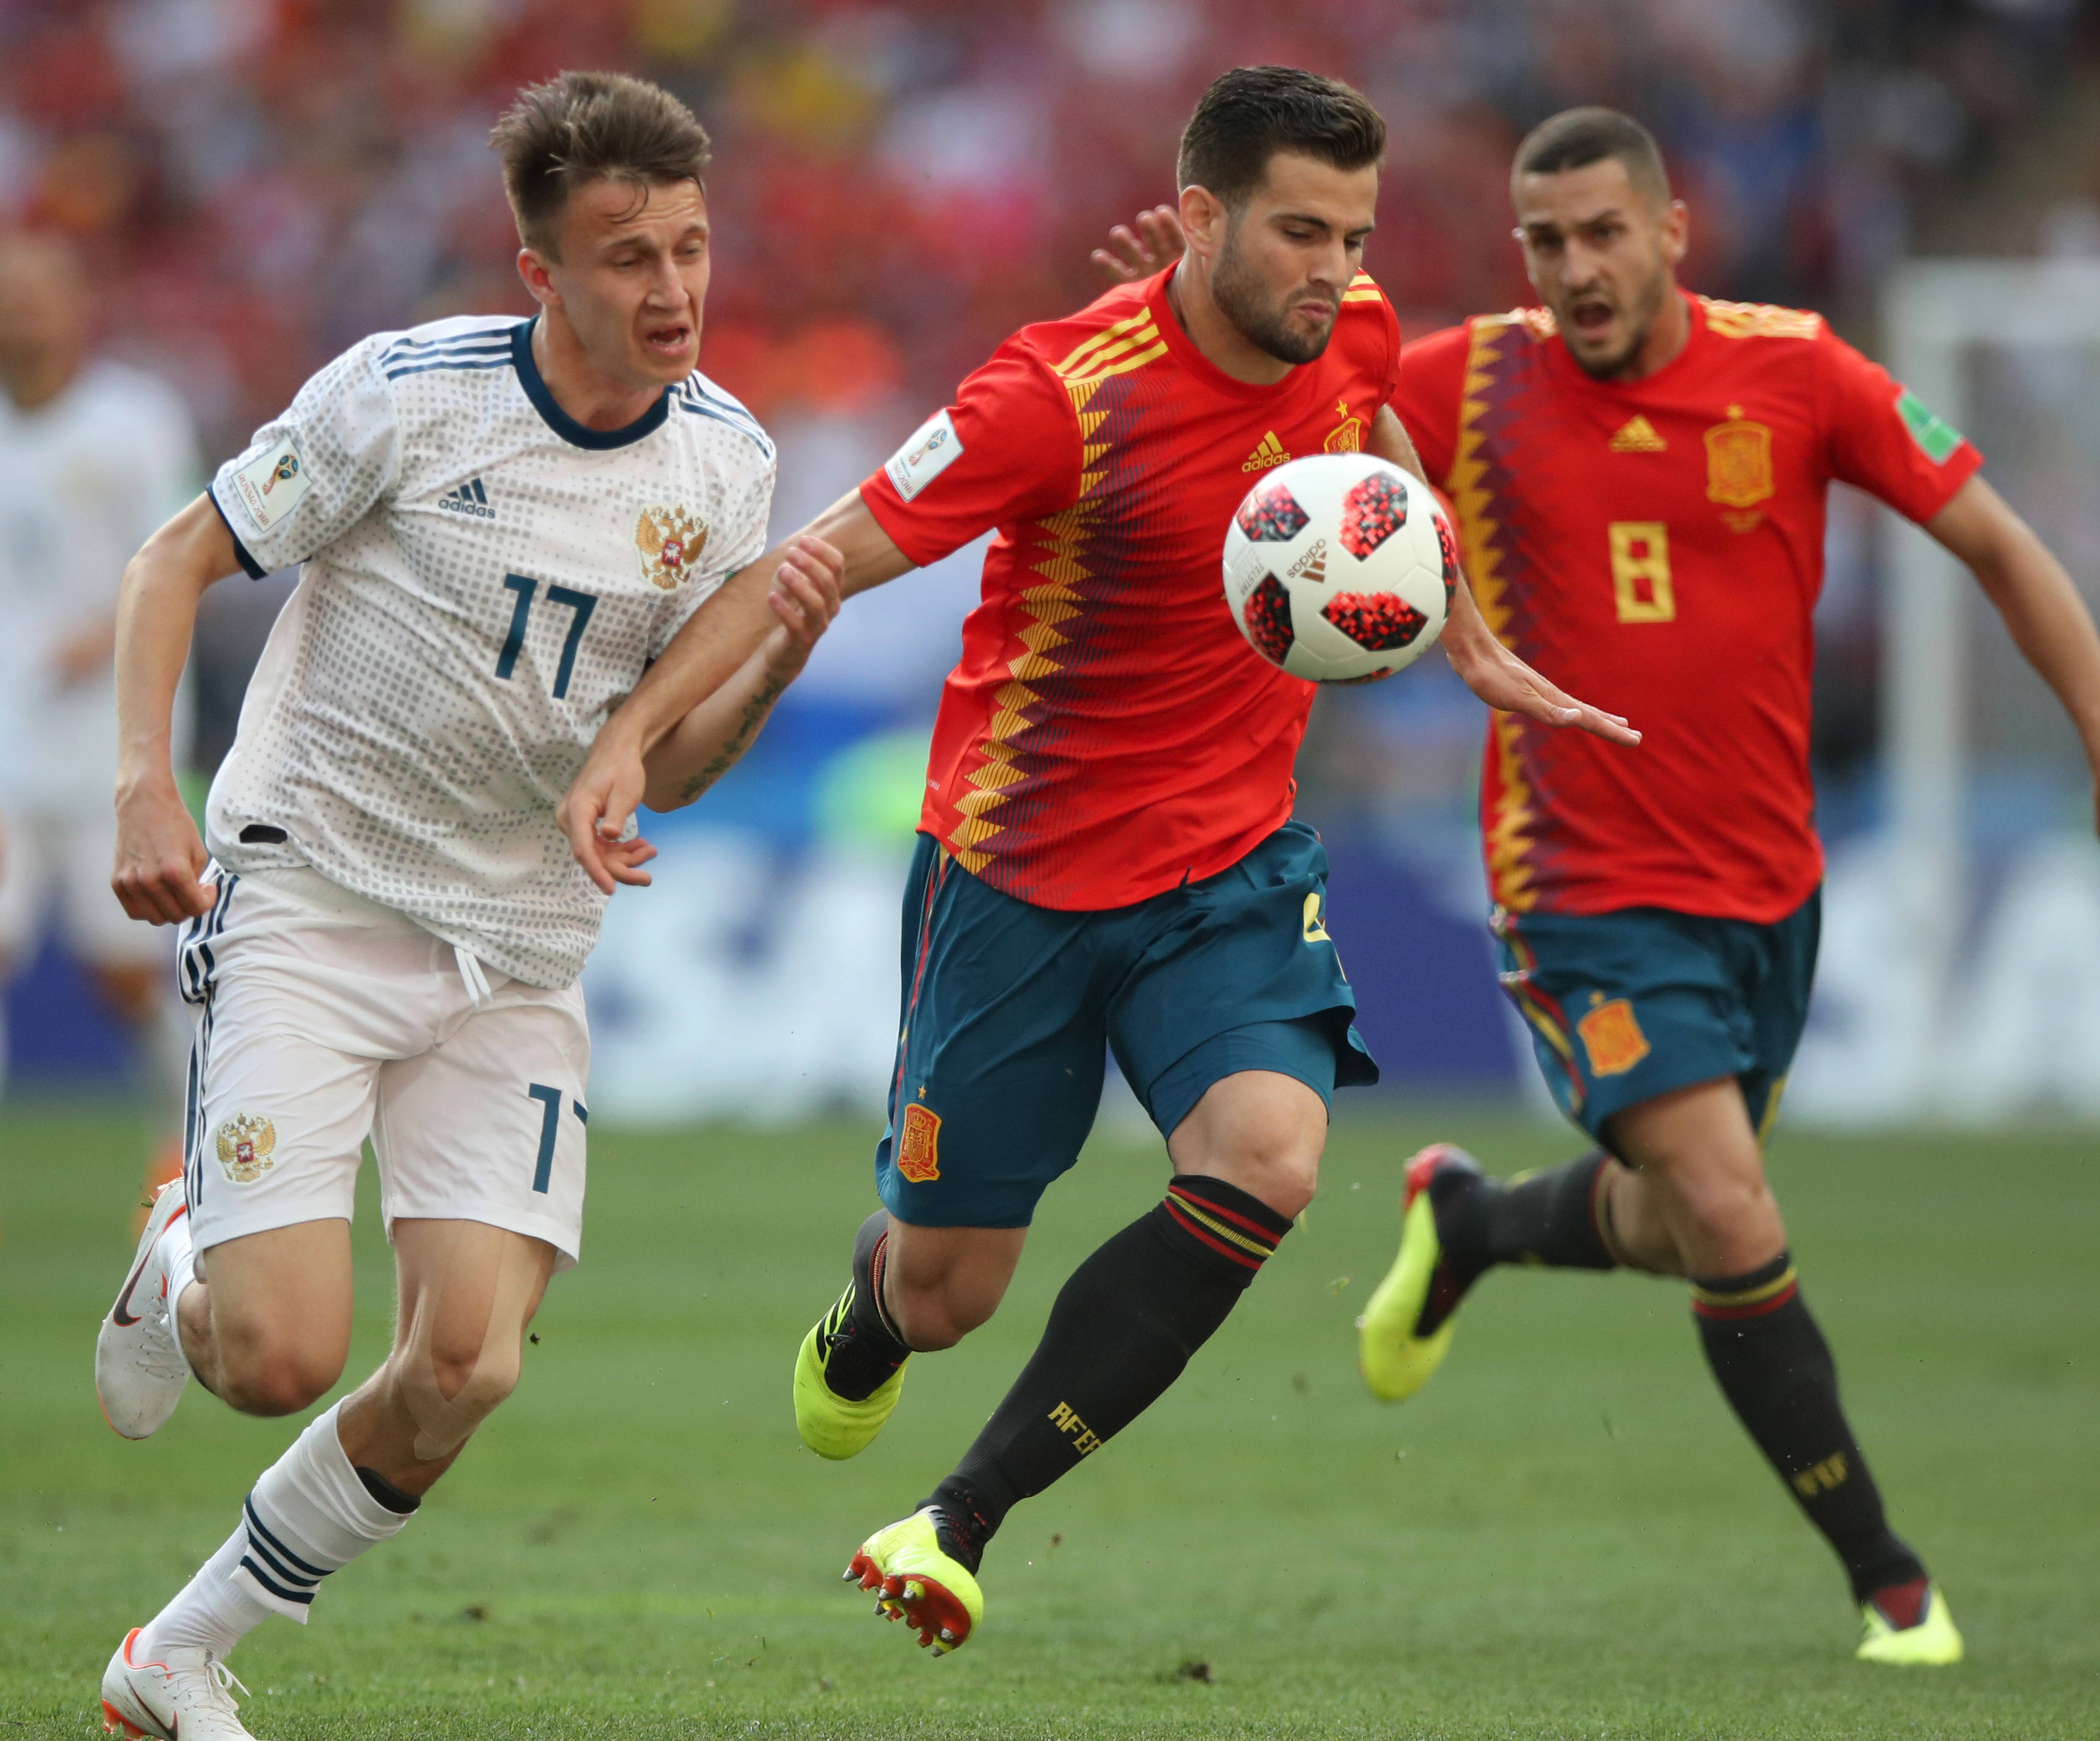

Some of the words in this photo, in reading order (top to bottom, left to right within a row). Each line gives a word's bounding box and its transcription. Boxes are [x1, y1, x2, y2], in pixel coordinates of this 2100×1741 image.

[1241, 453, 1290, 473] adidas
[238, 474, 257, 505] RUSSIA
[253, 505, 270, 525] 2018
[438, 497, 496, 519] adidas
[1287, 539, 1326, 579] adidas
[1609, 522, 1676, 622] 8
[495, 572, 598, 700] 17
[529, 1083, 588, 1194] 1
